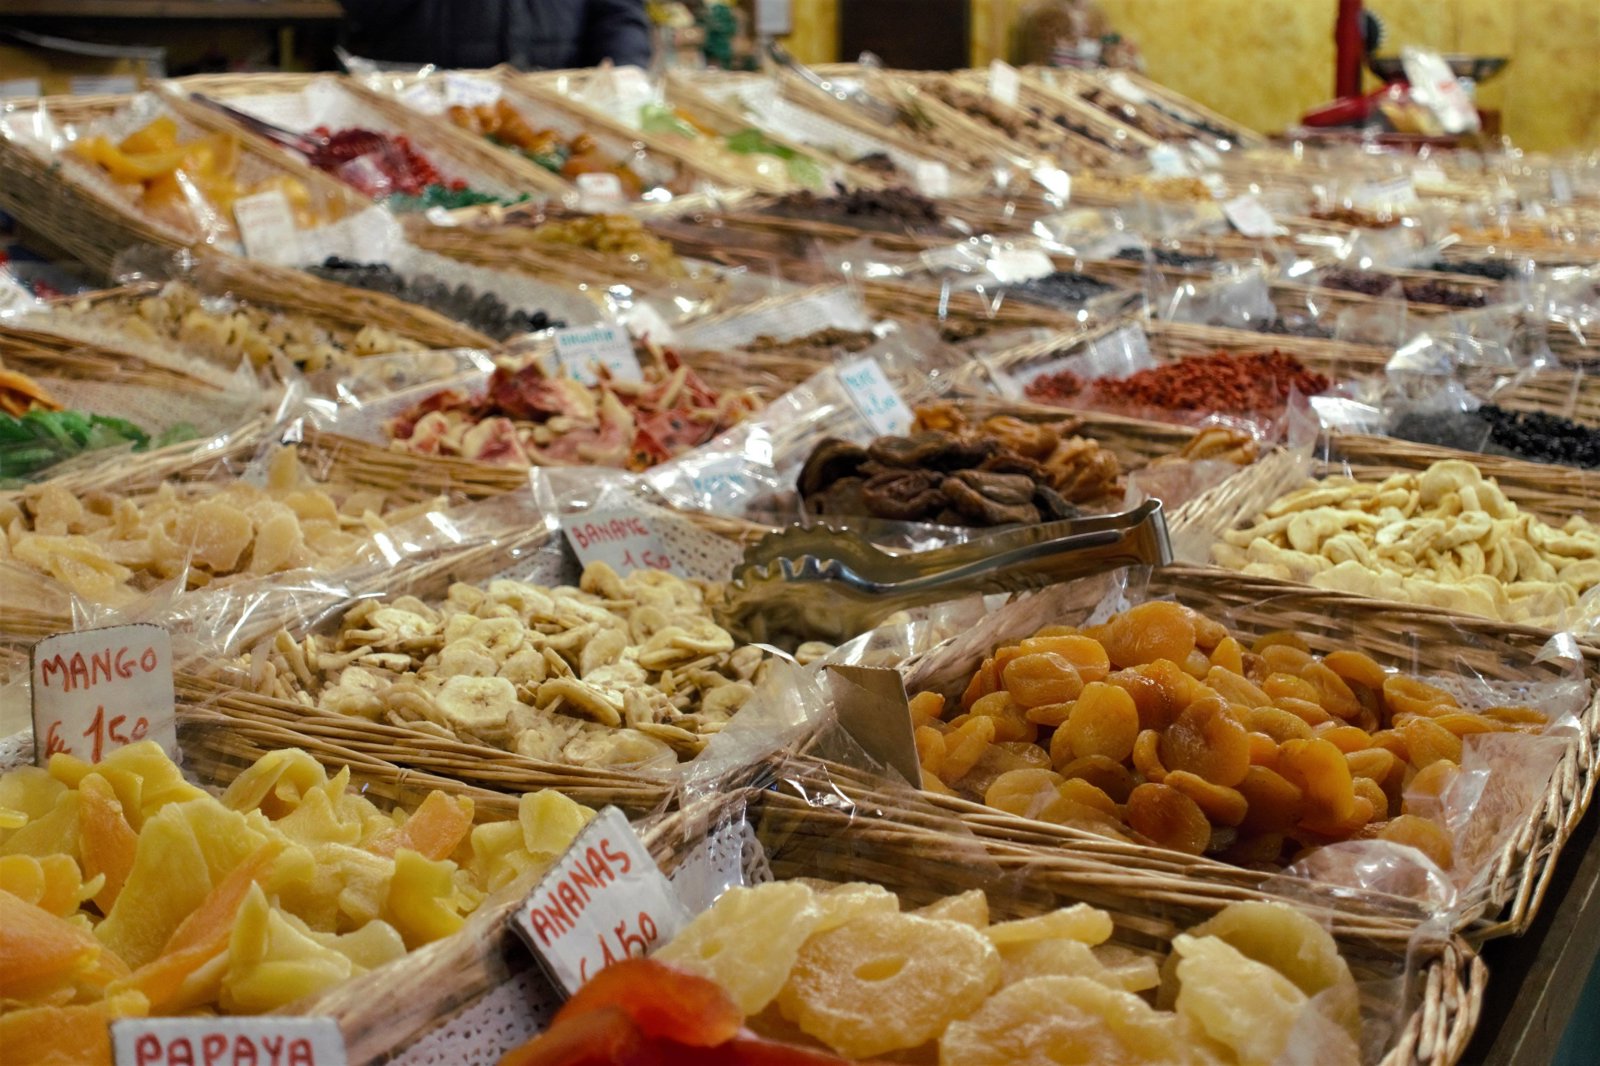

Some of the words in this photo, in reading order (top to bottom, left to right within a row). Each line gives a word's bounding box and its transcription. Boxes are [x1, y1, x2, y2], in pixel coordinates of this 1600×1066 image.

[41, 647, 157, 692] MANGO
[530, 838, 631, 947] ANANAS
[135, 1032, 315, 1066] PAPAYA
